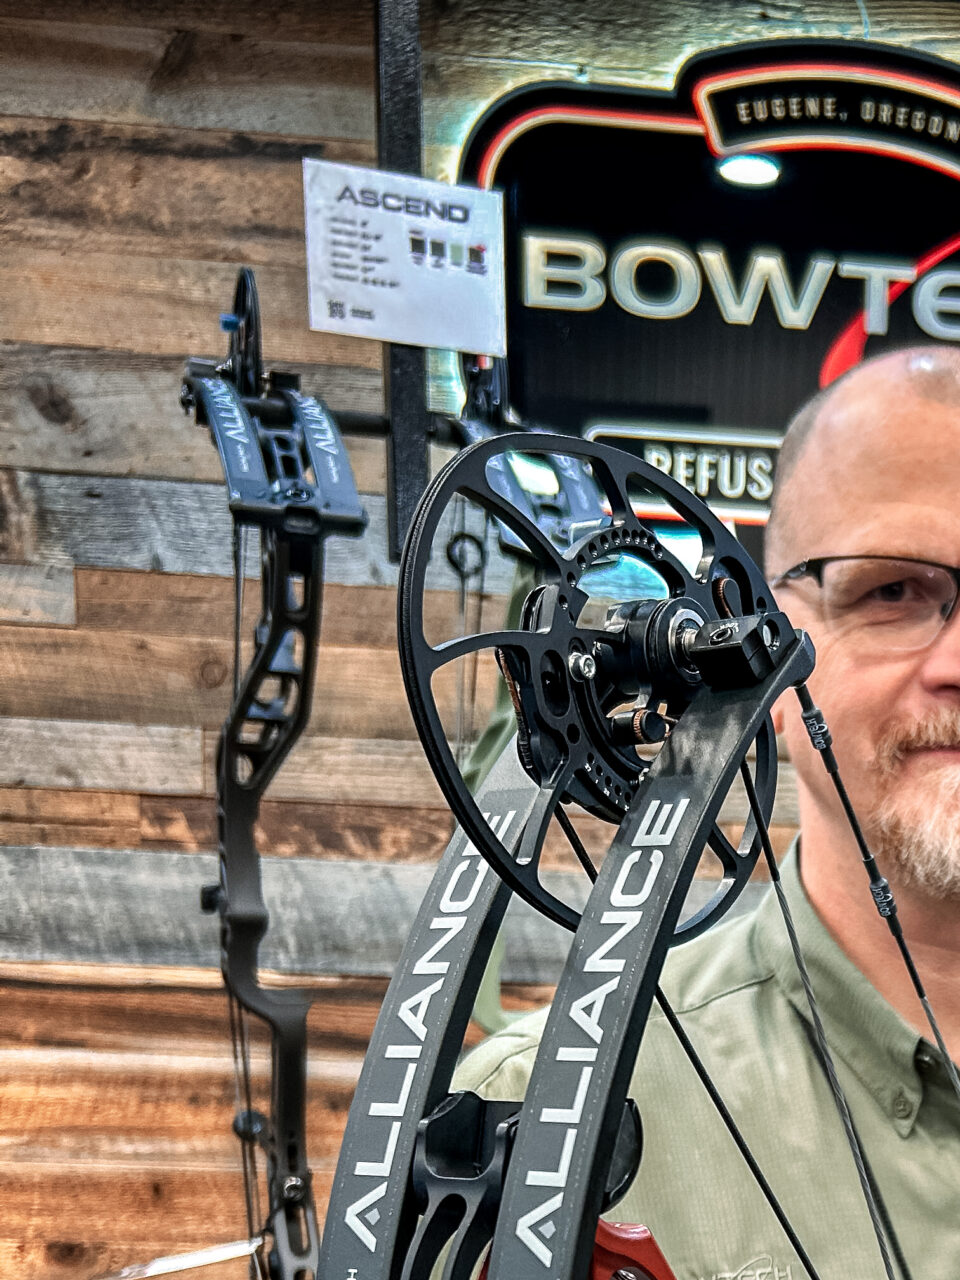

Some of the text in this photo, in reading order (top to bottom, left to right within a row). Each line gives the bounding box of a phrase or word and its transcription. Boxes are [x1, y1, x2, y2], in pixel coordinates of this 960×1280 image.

[736, 97, 848, 123] EUGENE,
[336, 185, 470, 224] ASCEND
[644, 446, 773, 500] REFUS
[344, 810, 516, 1253] ALLIANCE
[514, 798, 691, 1269] ALLIANCE
